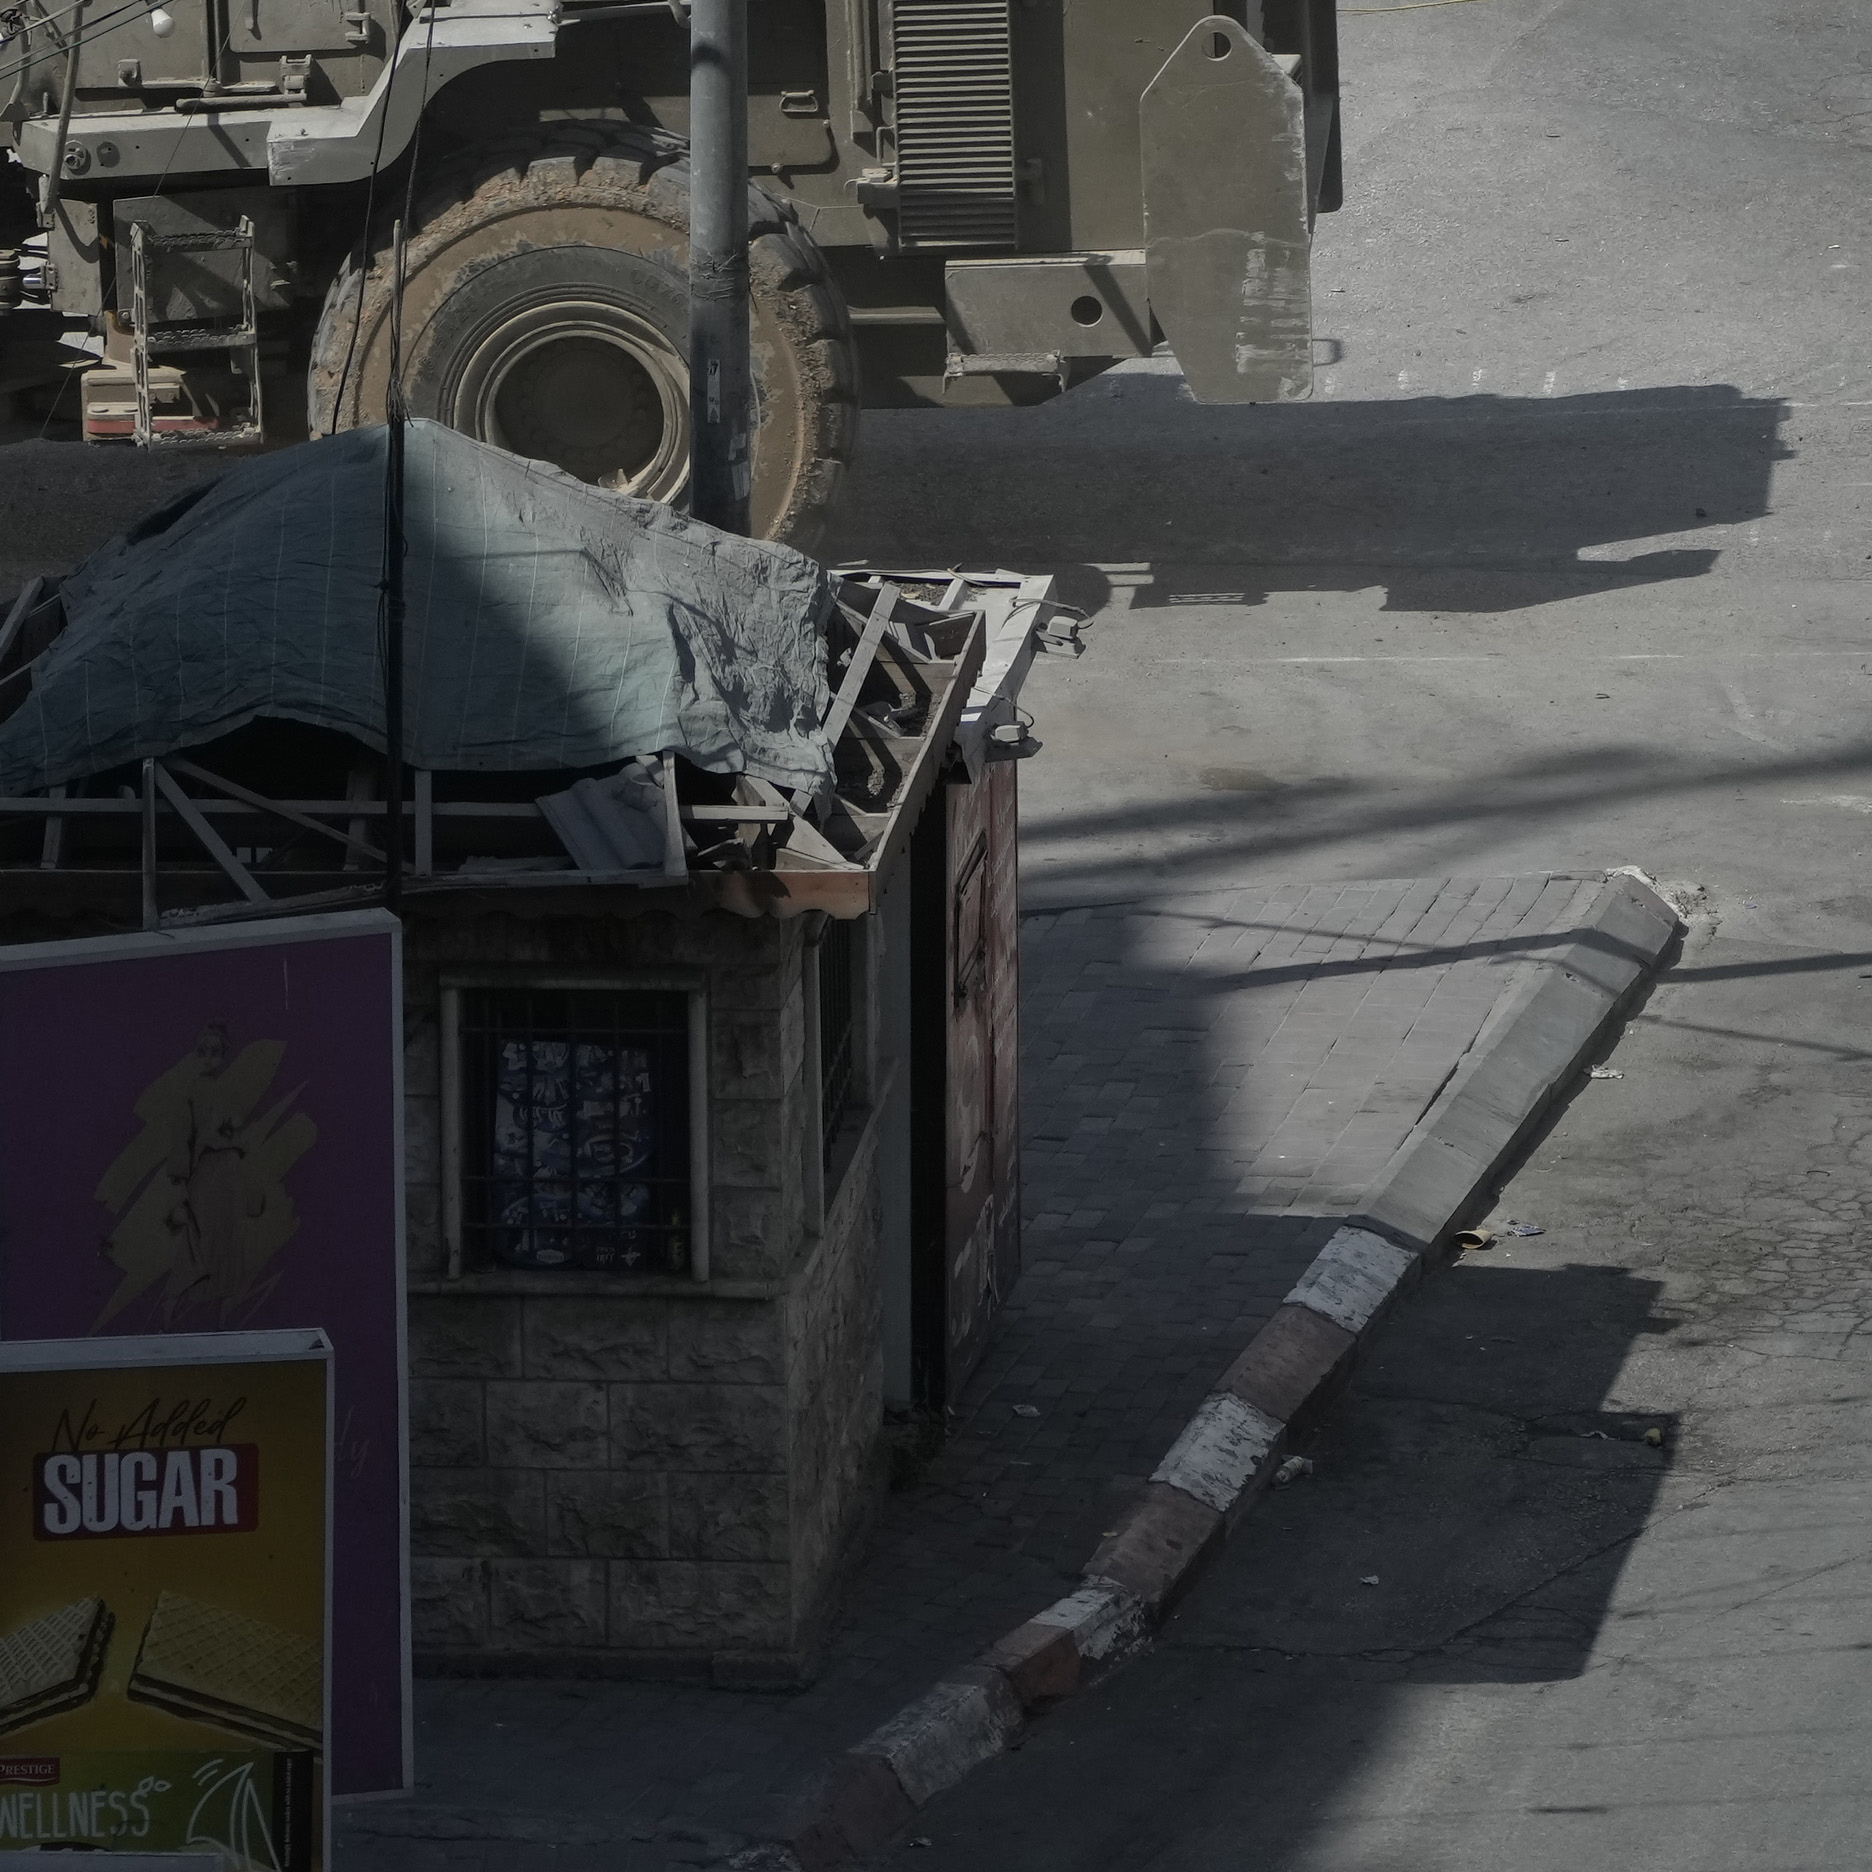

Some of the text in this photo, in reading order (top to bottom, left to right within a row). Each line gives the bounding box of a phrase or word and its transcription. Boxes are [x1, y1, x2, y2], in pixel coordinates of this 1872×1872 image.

[50, 1395, 247, 1452] No Added
[41, 1448, 240, 1534] SUGAR
